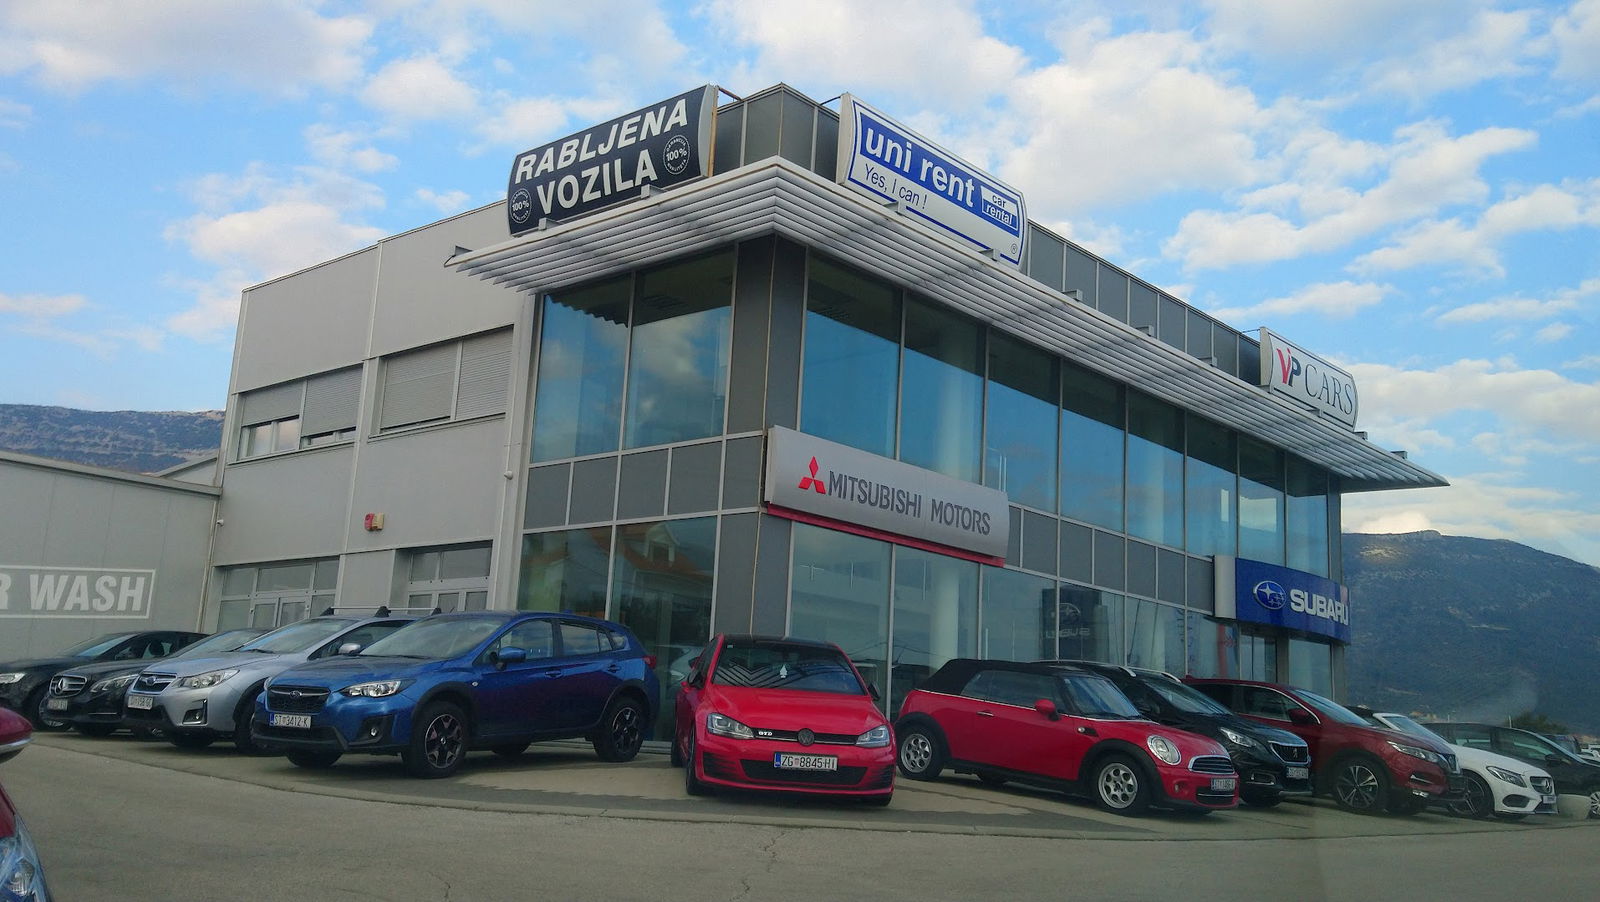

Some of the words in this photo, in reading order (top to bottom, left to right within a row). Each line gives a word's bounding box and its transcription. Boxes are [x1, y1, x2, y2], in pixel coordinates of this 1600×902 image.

[515, 98, 688, 185] RABLJENA
[666, 147, 688, 161] 100%
[537, 149, 659, 215] VOZILA
[865, 127, 912, 173] uni
[919, 158, 975, 208] rent
[865, 163, 888, 192] Yes,
[891, 178, 897, 194] I
[512, 200, 529, 211] 100%
[986, 202, 1013, 225] rental
[991, 193, 1007, 208] car
[1305, 363, 1353, 415] CARS
[828, 470, 922, 519] MITSUBISHI
[931, 498, 991, 536] MOTORS
[29, 574, 146, 611] WASH
[1290, 588, 1349, 626] SUBARU
[781, 755, 794, 767] ZG
